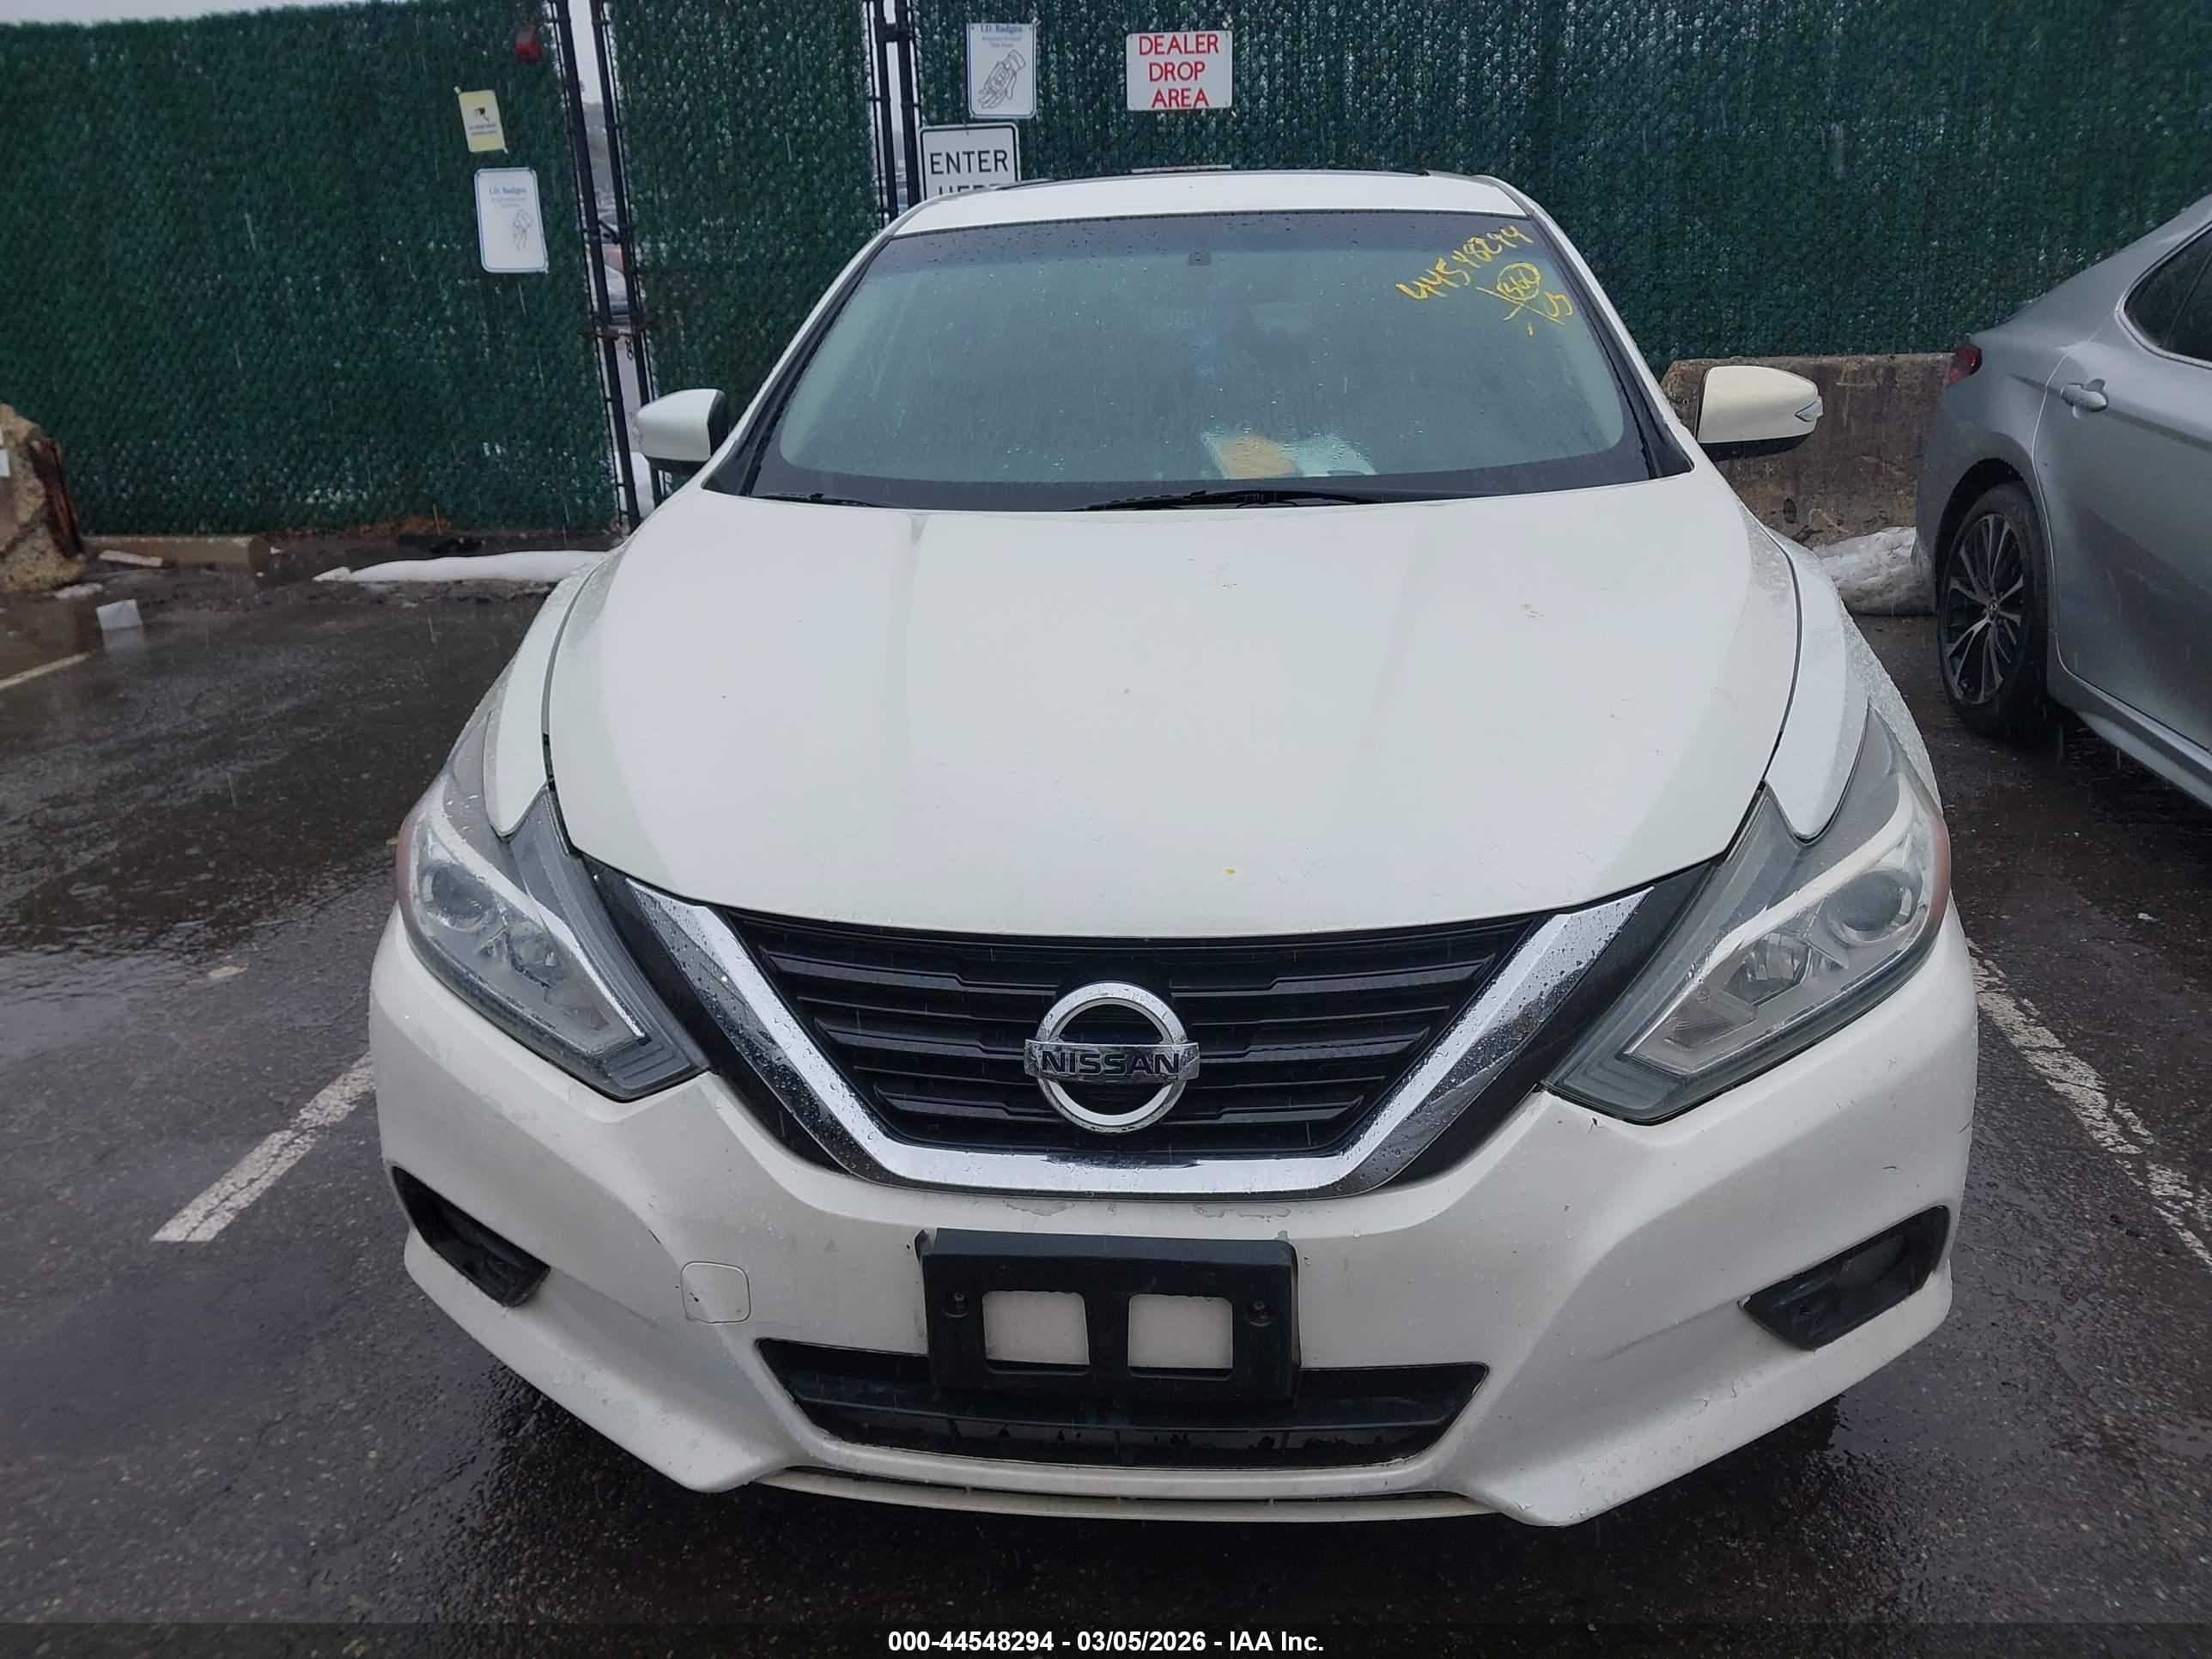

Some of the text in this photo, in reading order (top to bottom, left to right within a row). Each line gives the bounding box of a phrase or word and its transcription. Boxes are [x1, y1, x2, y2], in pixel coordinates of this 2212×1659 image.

[996, 24, 1023, 34] Badges
[1139, 33, 1219, 56] DEALER
[1149, 61, 1206, 82] DROP
[1151, 87, 1210, 108] AREA
[930, 149, 1008, 174] ENTER
[1395, 225, 1534, 301] 44548294
[1041, 1050, 1180, 1073] NISSAN
